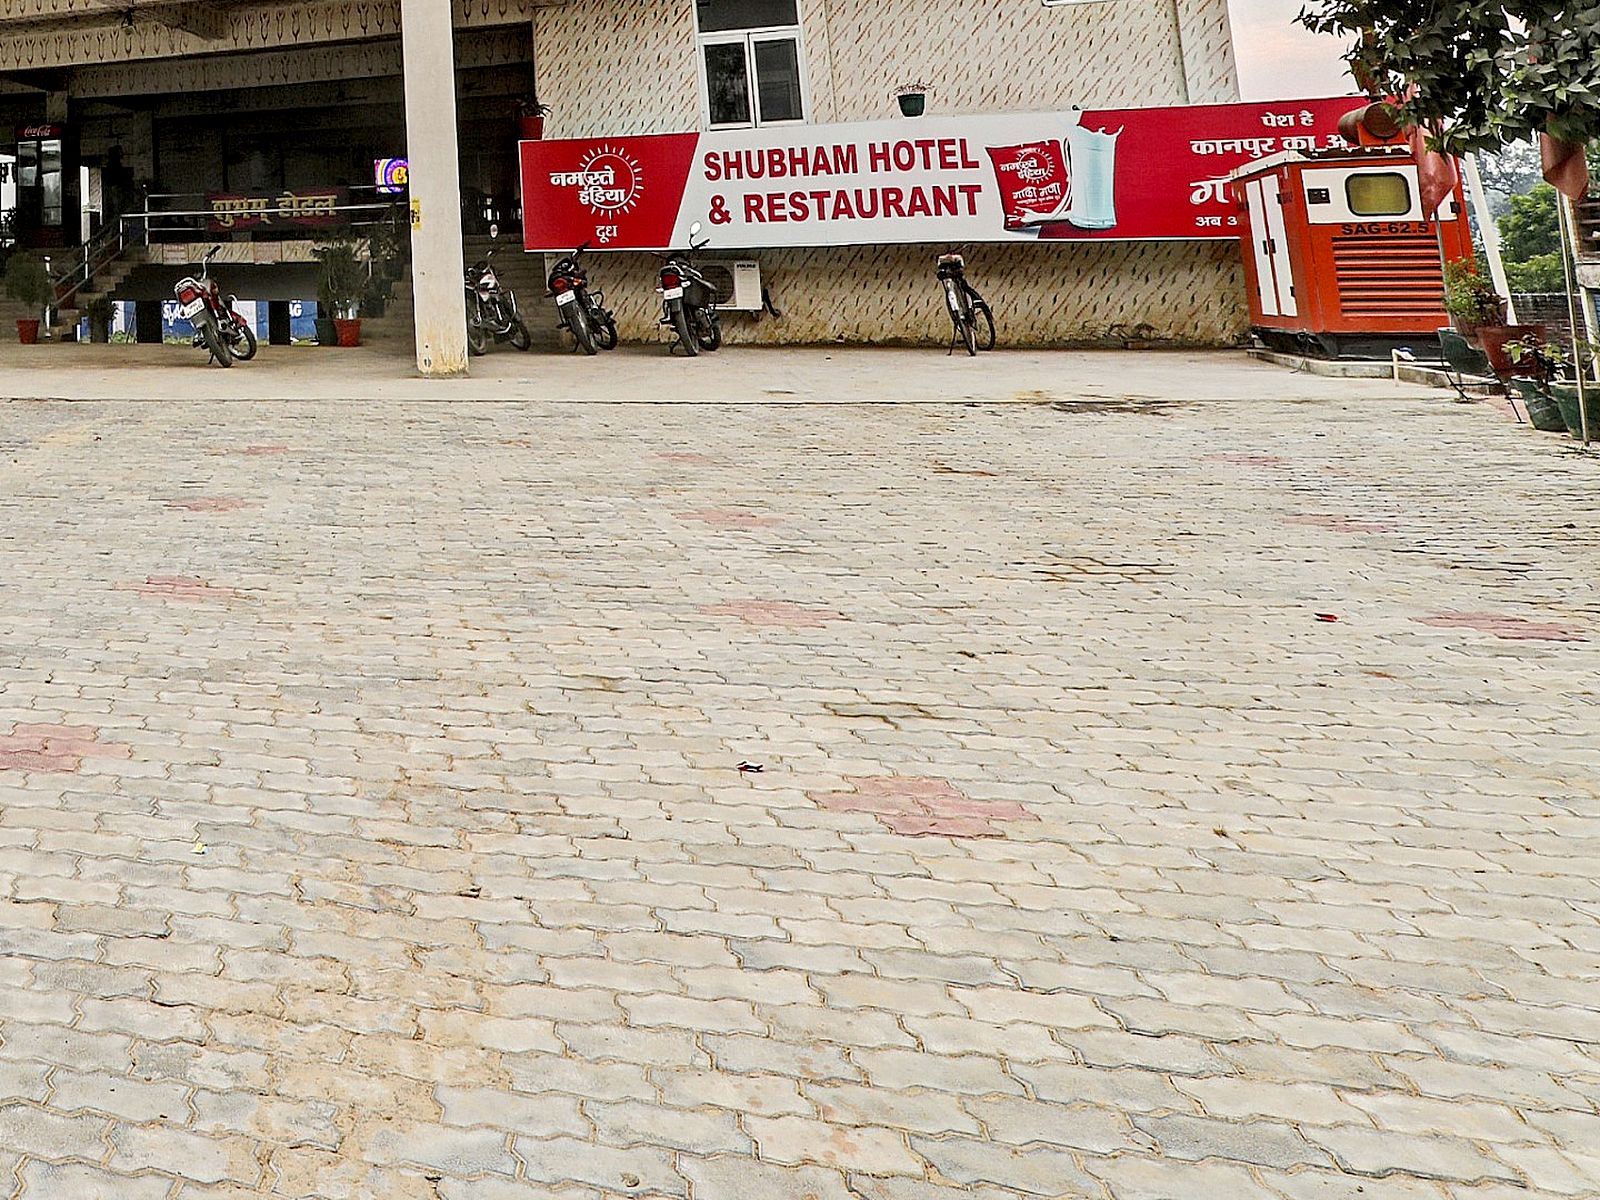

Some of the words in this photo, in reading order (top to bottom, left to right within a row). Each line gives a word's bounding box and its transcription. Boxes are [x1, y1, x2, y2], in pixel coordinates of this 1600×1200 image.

[1260, 113, 1295, 127] पेश
[1299, 110, 1315, 127] है
[1190, 137, 1276, 157] कानपुर
[1280, 135, 1316, 152] का
[703, 143, 859, 181] SHUBHAM
[868, 138, 980, 173] HOTEL
[550, 165, 615, 187] नमस्ते
[708, 194, 733, 225] &
[743, 184, 983, 223] RESTAURANT
[1195, 216, 1222, 227] अब
[1341, 221, 1430, 236] SAG-62.5
[596, 225, 618, 244] दूध
